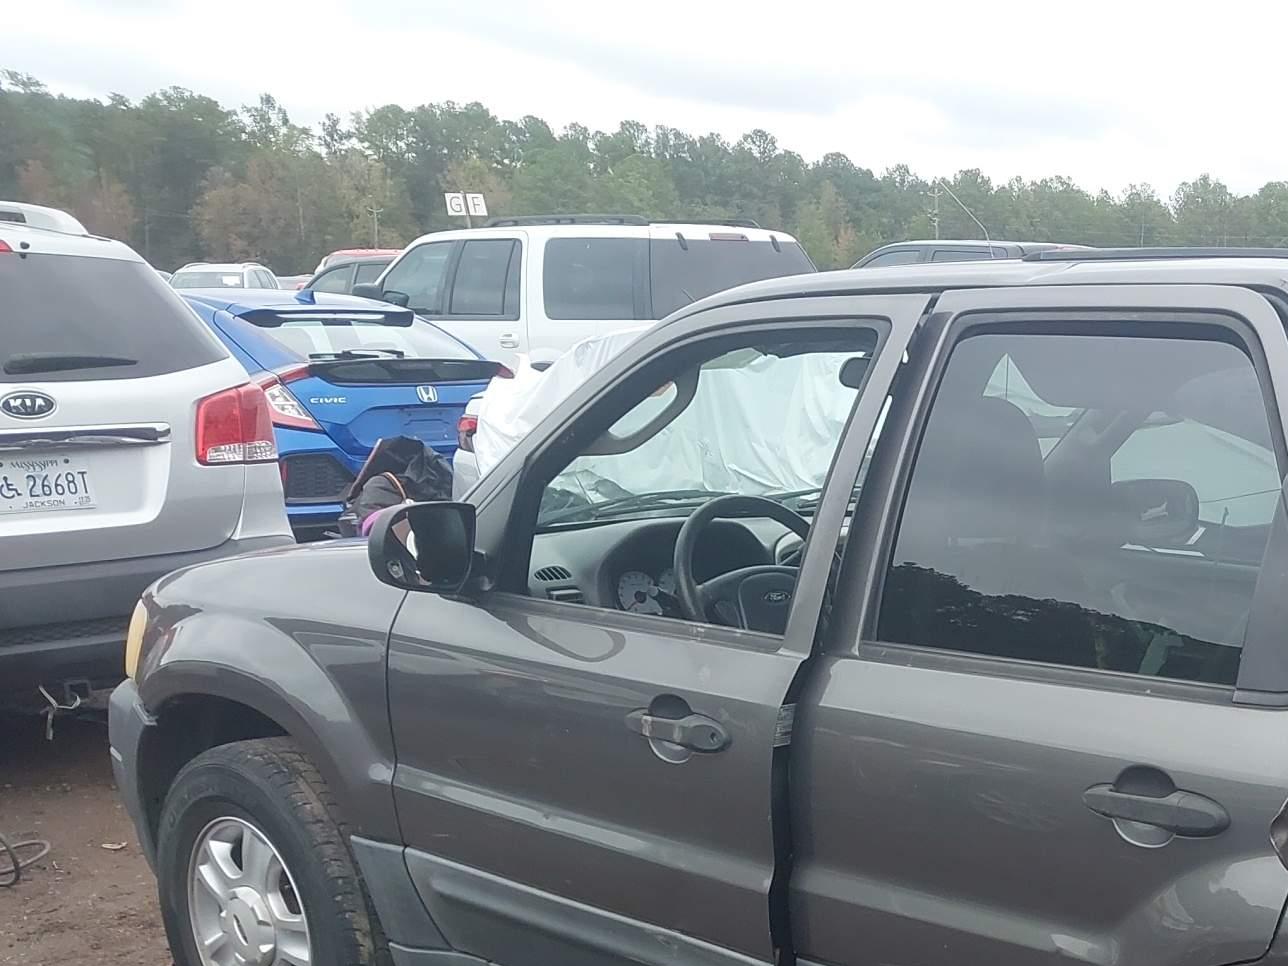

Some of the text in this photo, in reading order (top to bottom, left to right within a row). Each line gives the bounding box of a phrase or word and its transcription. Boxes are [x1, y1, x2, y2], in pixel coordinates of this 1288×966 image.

[450, 196, 481, 213] G F
[25, 470, 88, 498] 2668T
[23, 499, 65, 509] JACKSON
